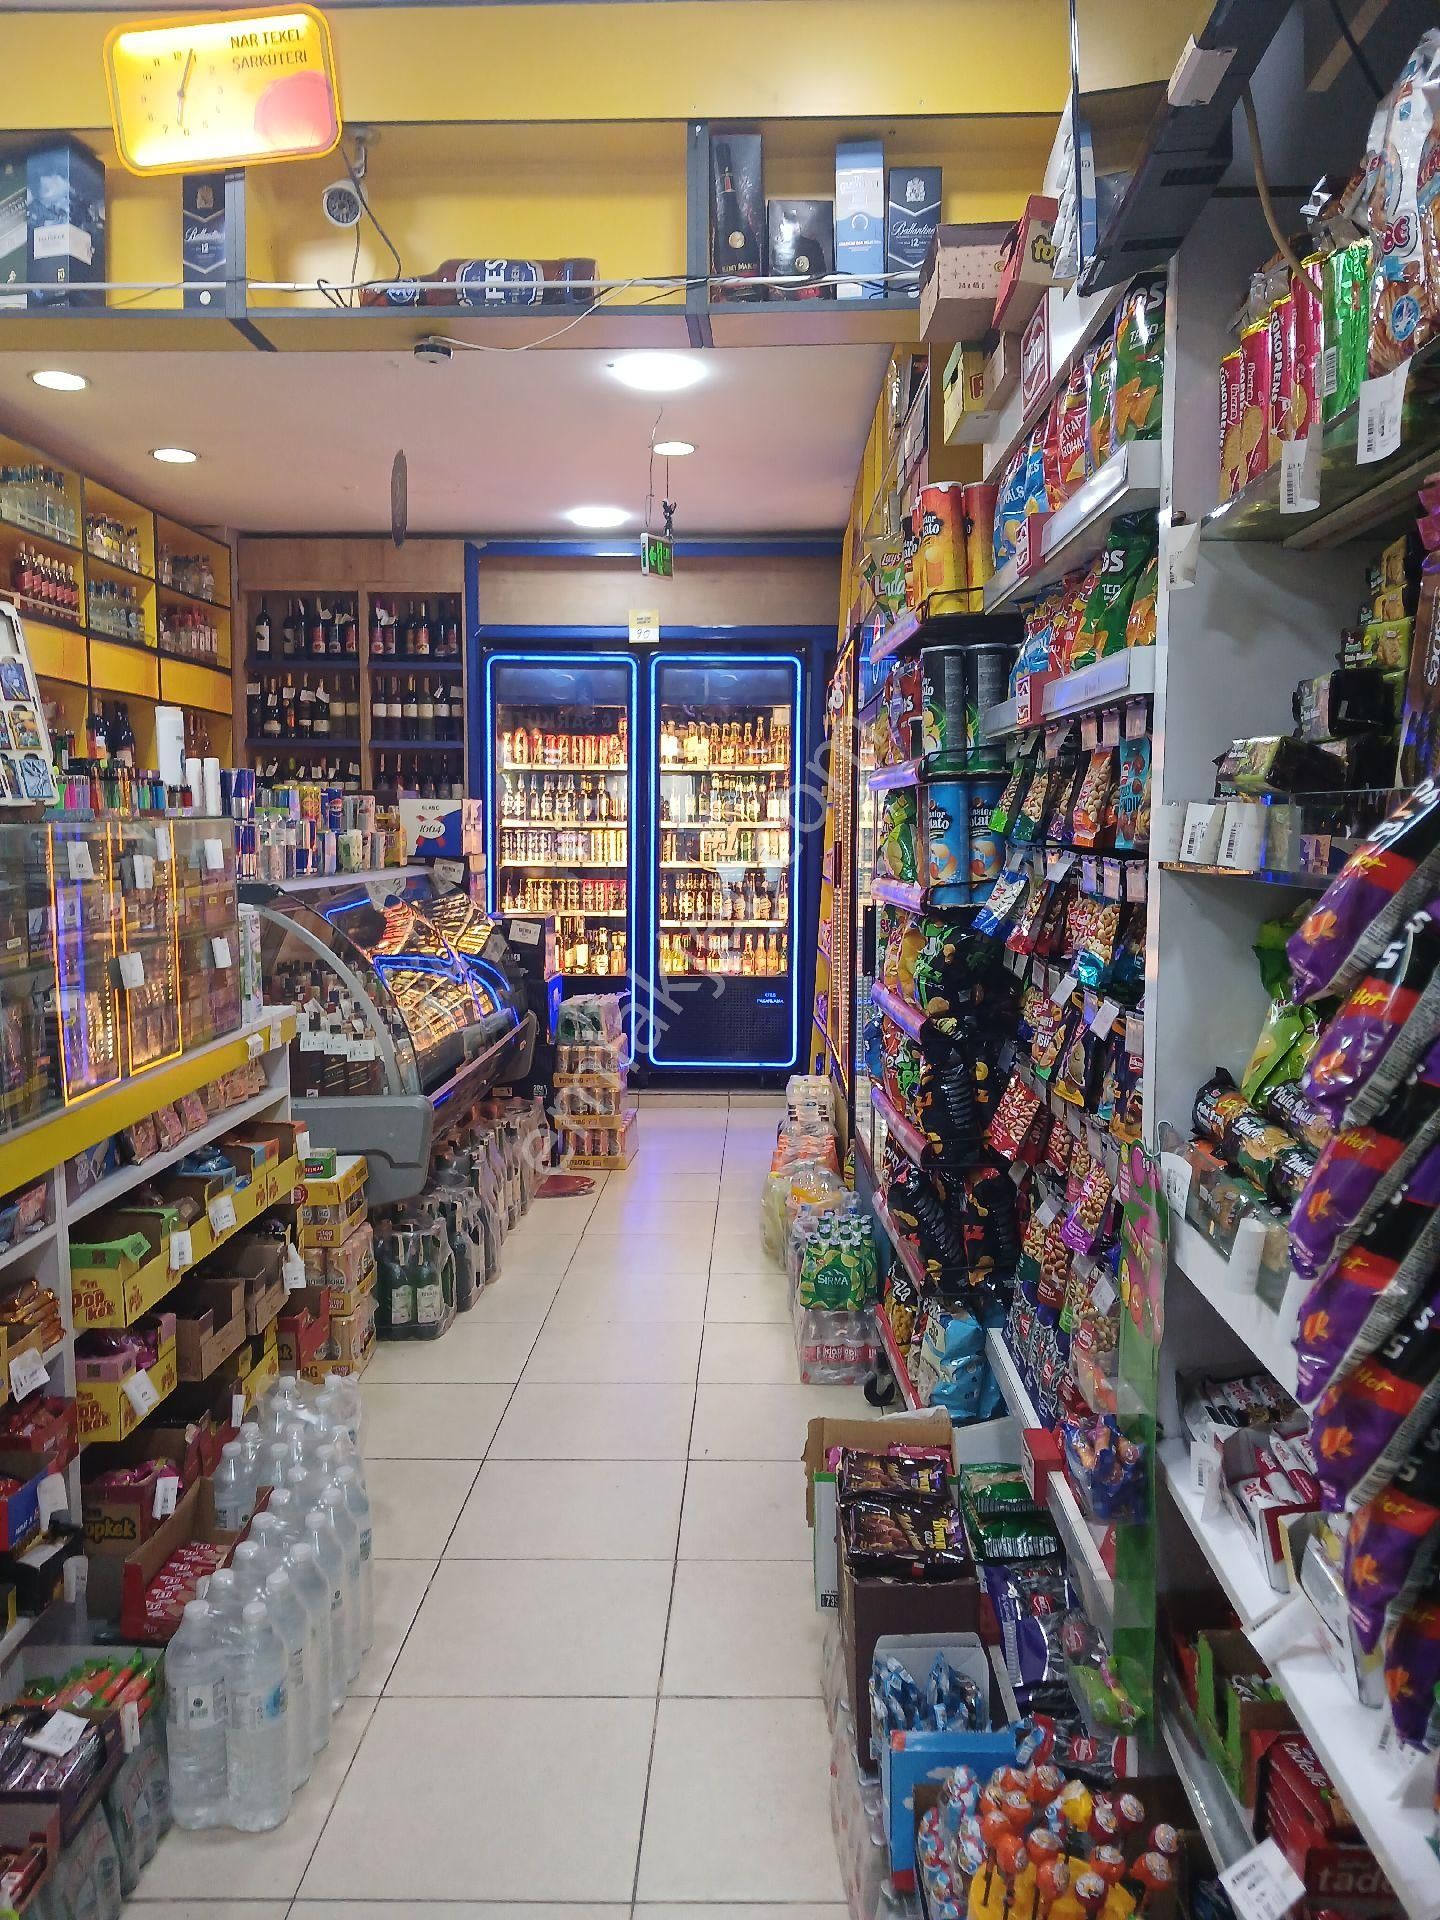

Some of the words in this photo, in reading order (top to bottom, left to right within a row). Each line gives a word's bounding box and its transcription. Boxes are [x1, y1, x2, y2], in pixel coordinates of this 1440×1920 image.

[230, 33, 258, 49] NAR
[262, 29, 304, 45] TEKEL
[892, 220, 936, 237] Ballantine
[910, 238, 920, 249] 12
[484, 258, 508, 308] FES
